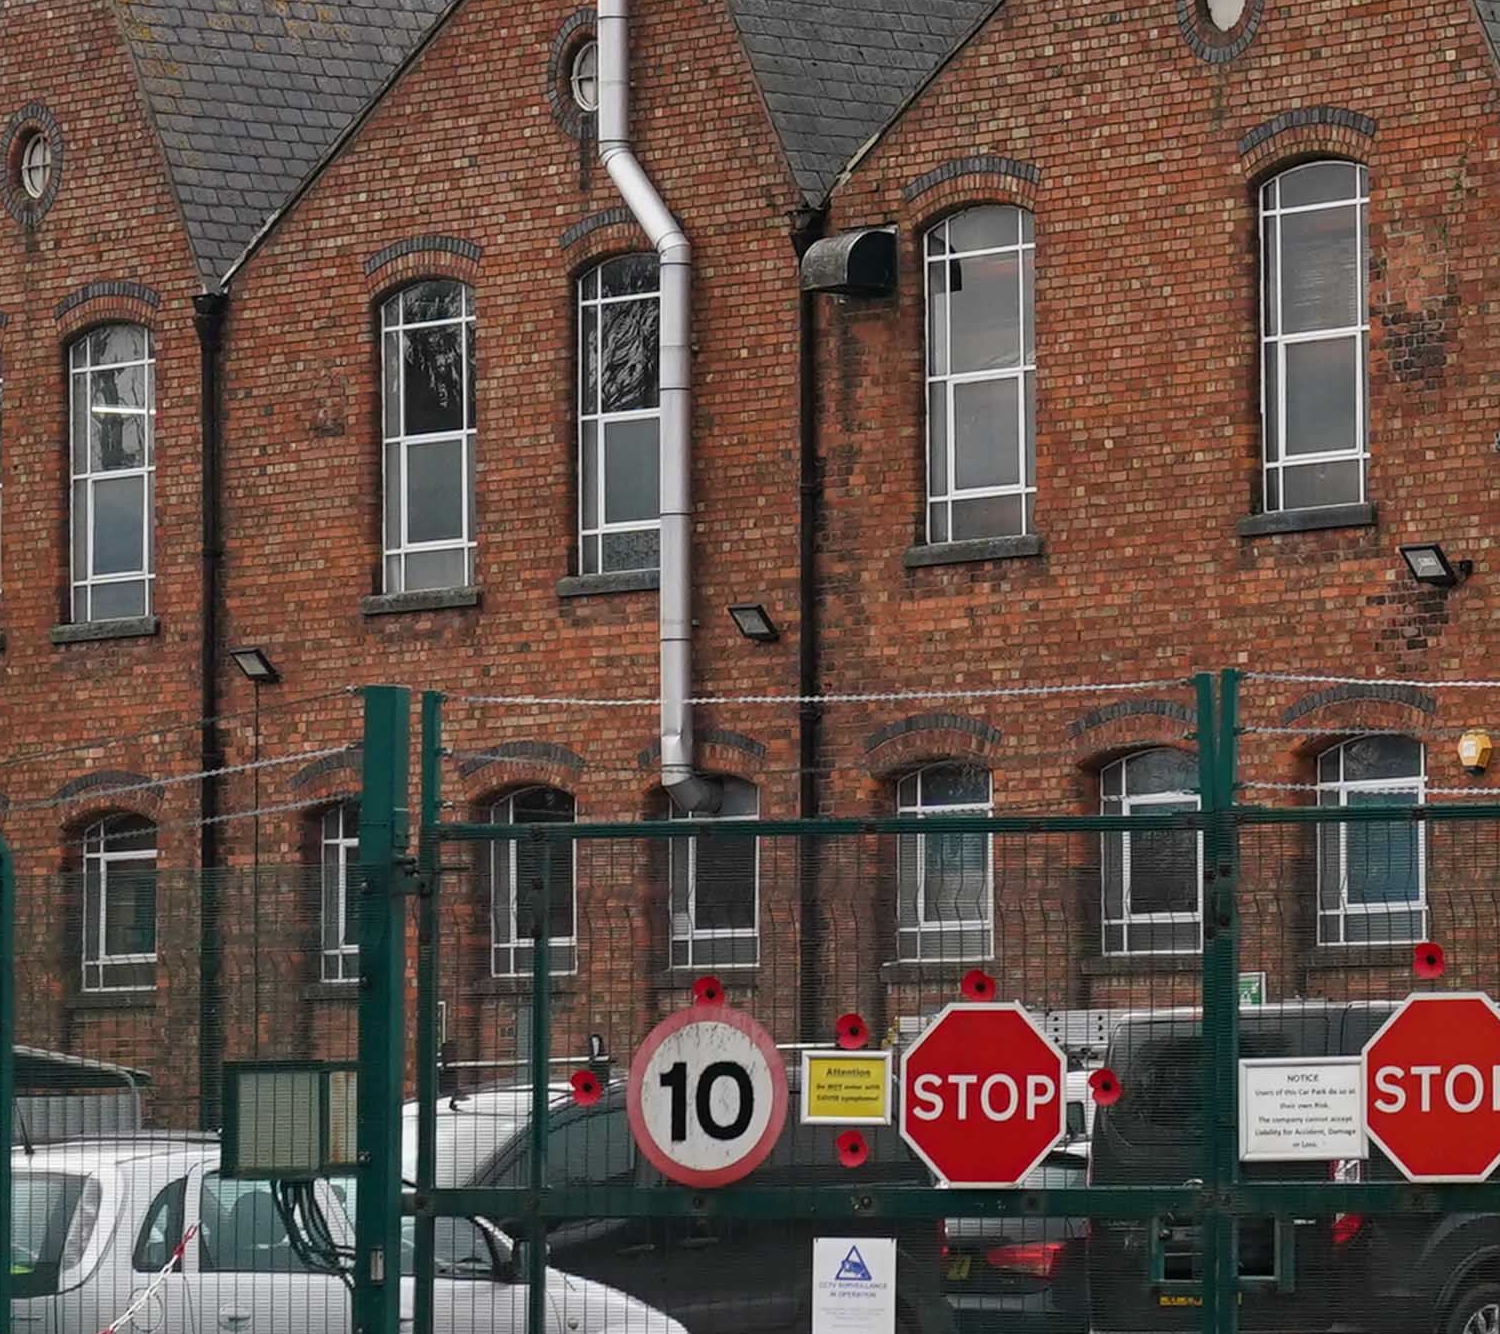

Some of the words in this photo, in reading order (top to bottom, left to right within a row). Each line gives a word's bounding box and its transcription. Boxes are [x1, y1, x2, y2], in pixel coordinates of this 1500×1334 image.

[826, 1068, 871, 1076] Attention
[1287, 1074, 1319, 1082] NOTICE
[1255, 1088, 1274, 1096] Users
[1275, 1088, 1283, 1096] of
[660, 1061, 754, 1142] 10
[912, 1073, 1056, 1121] STOP
[1272, 1117, 1303, 1125] company
[1330, 1116, 1353, 1124] accept
[1255, 1129, 1282, 1137] Liability
[1328, 1128, 1357, 1137] Damage
